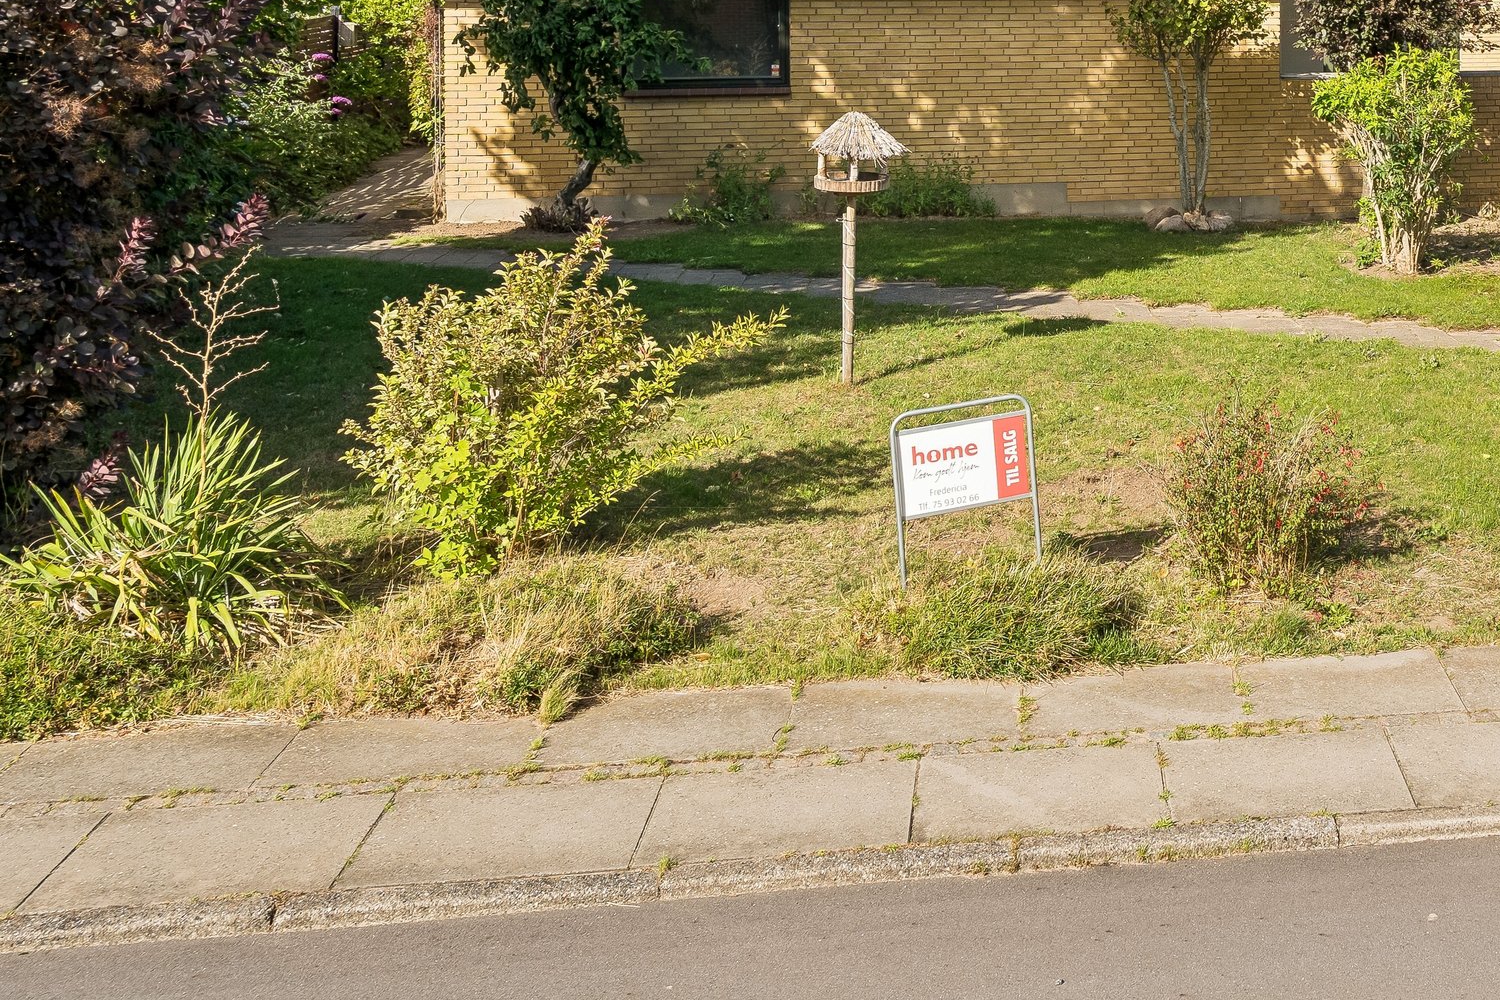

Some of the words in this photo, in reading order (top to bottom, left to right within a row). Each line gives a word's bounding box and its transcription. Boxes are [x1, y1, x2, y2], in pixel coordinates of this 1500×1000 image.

[911, 442, 978, 466] home
[1003, 429, 1018, 465] SALG
[1006, 465, 1020, 487] TIL
[929, 484, 968, 497] Fredericia
[918, 501, 931, 511] Tlf.
[932, 499, 943, 509] 75
[944, 497, 955, 507] 93
[956, 495, 967, 505] 02
[968, 493, 980, 502] 66
